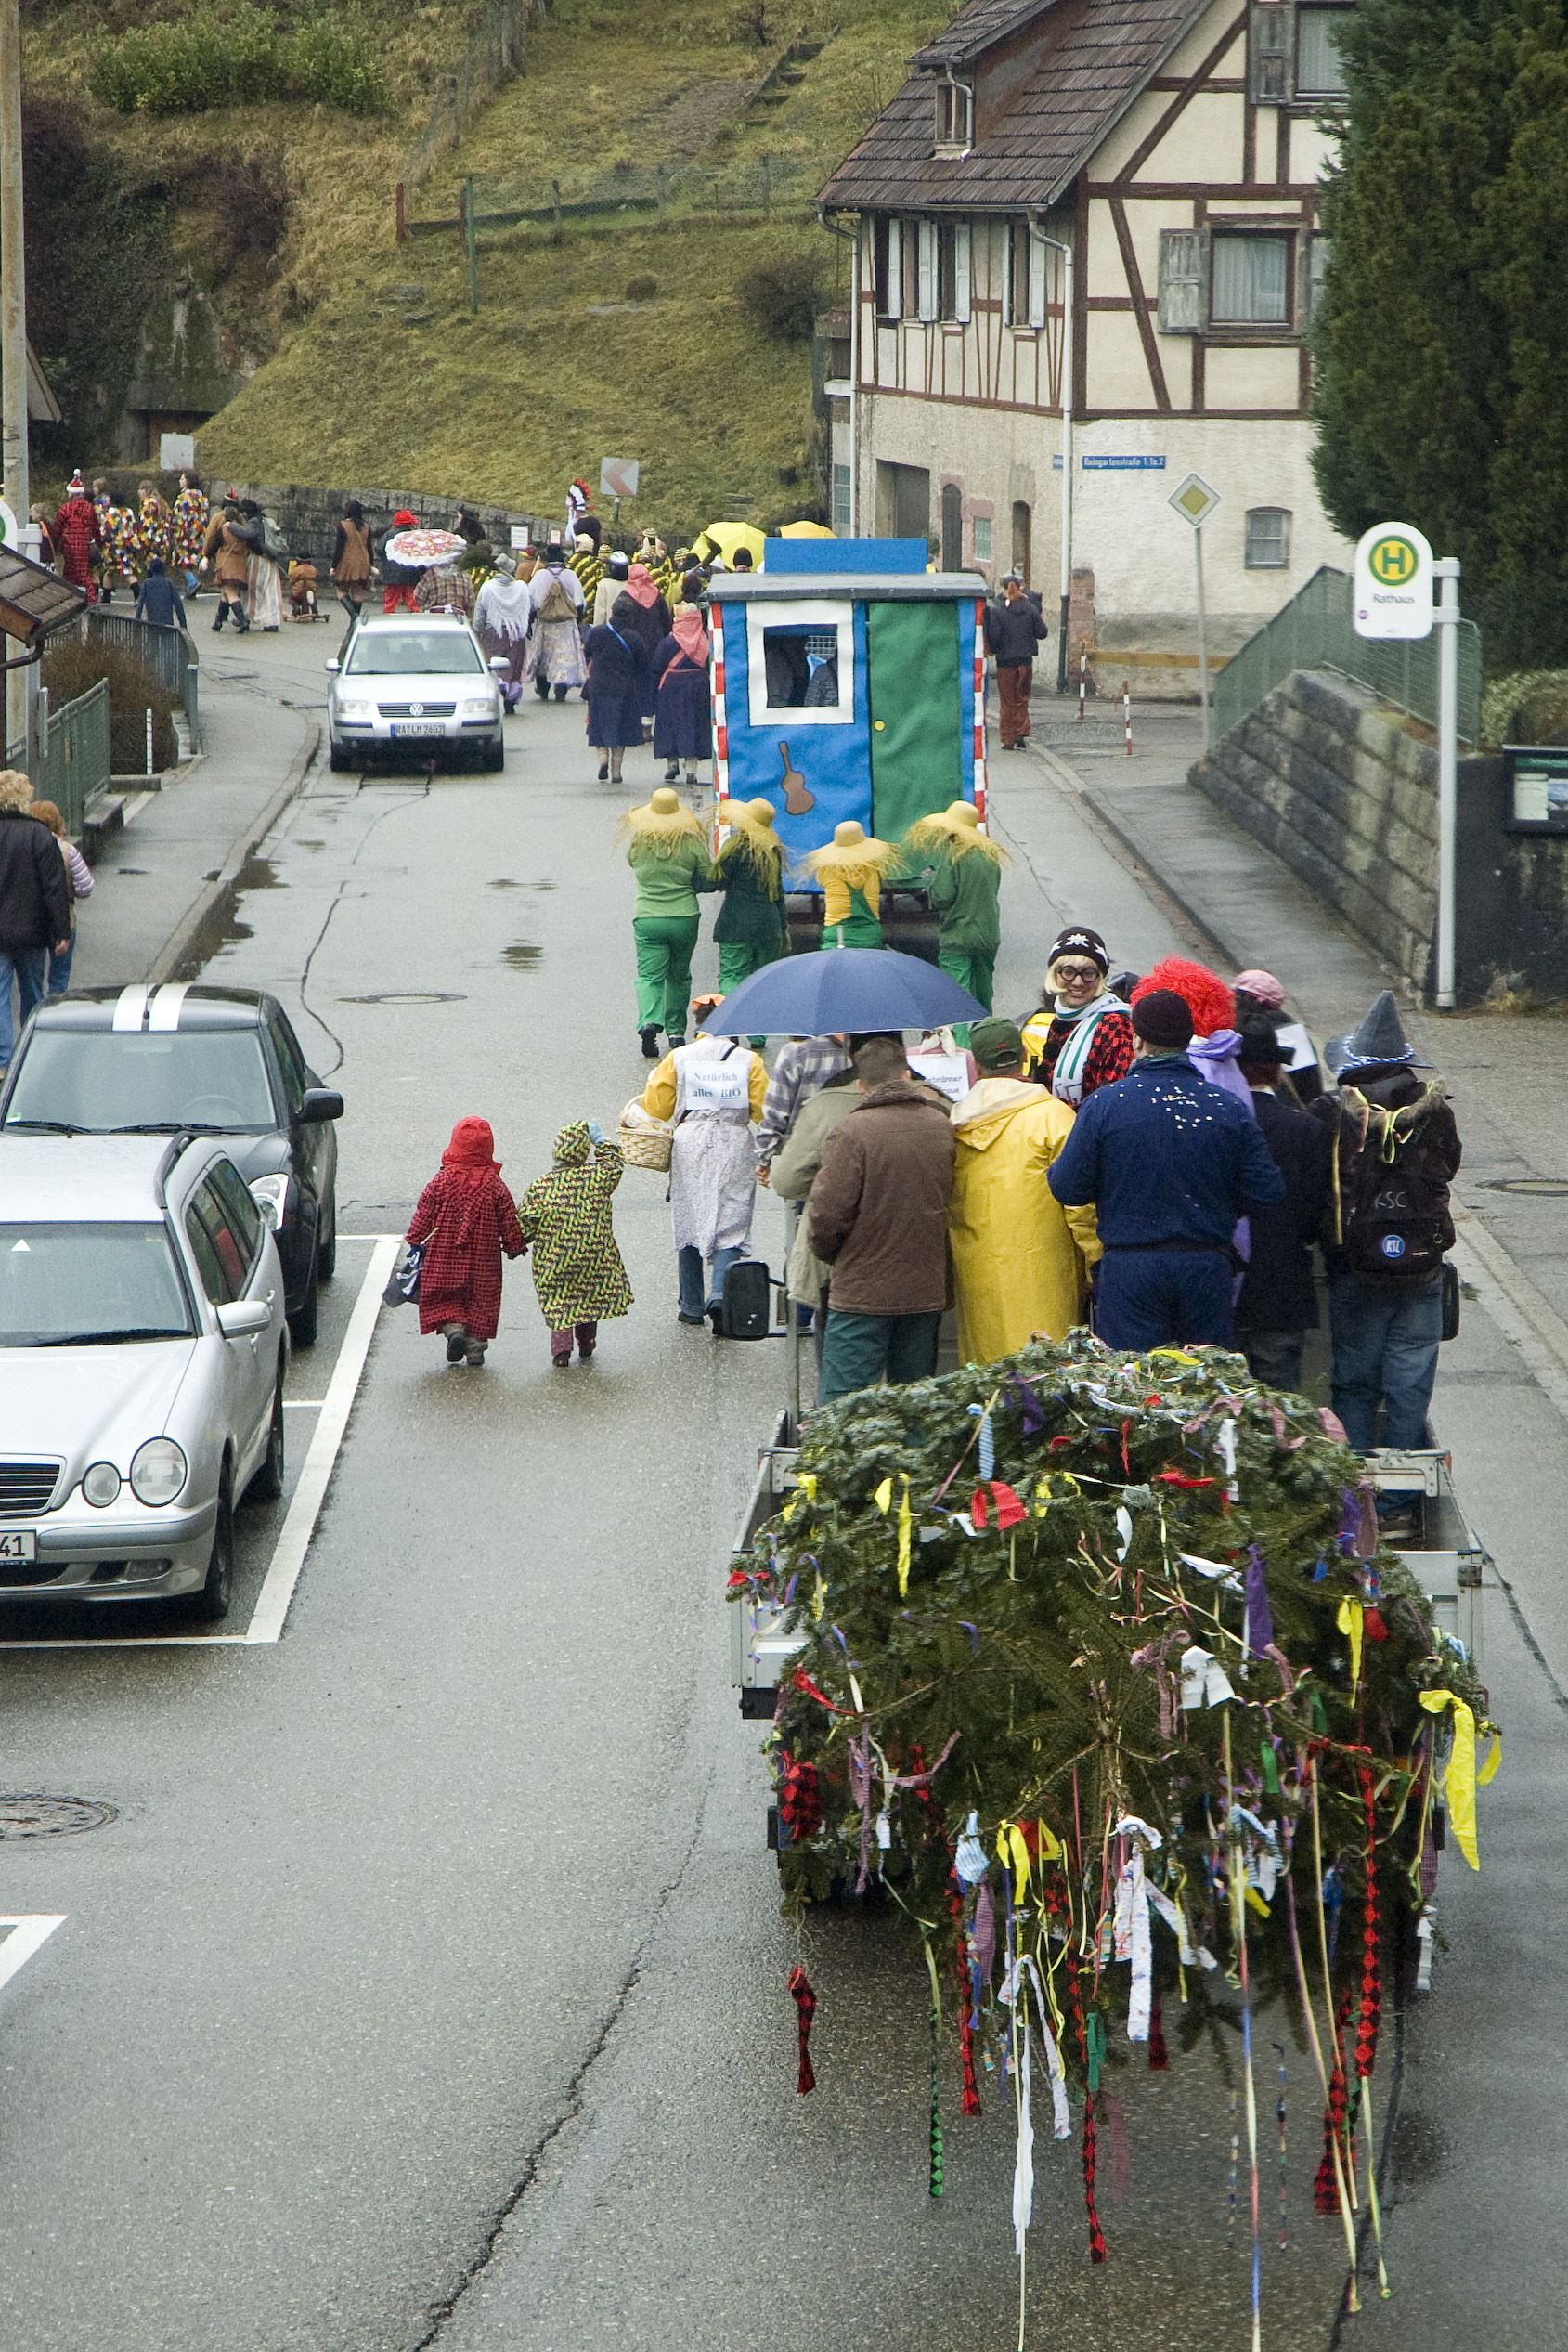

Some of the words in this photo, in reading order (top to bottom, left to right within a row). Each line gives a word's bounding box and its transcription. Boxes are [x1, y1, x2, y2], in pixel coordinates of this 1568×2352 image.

[1382, 546, 1406, 575] H
[1372, 593, 1416, 604] Rathaus
[411, 724, 422, 734] LM
[693, 1072, 739, 1082] Natürlich
[693, 1087, 714, 1098] alles
[720, 1087, 742, 1098] BIO
[1373, 1191, 1407, 1209] KSC
[1385, 1239, 1403, 1253] KSC
[0, 1535, 26, 1556] 41
